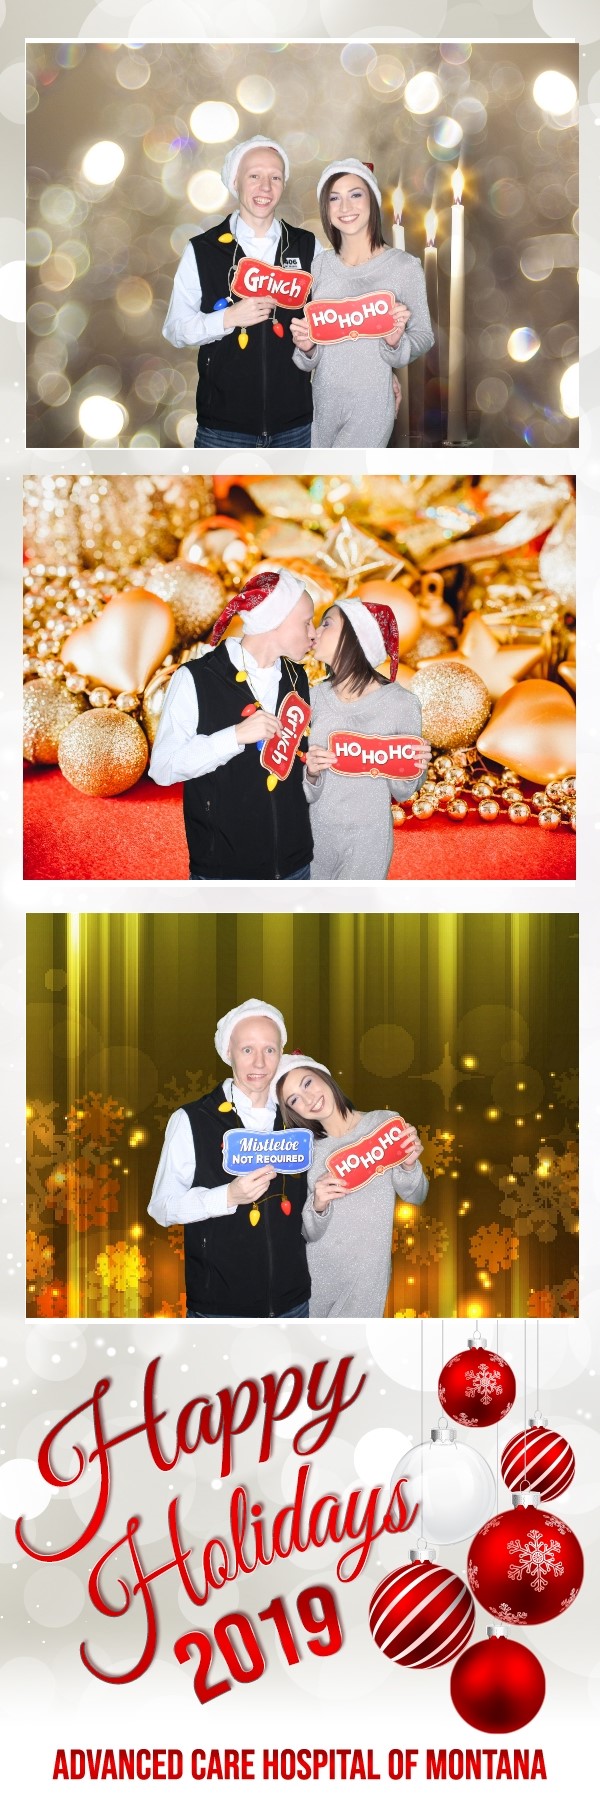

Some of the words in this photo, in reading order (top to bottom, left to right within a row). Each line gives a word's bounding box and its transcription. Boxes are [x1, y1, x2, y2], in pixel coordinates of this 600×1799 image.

[239, 1137, 300, 1152] Mistletoe
[232, 1154, 254, 1165] NOT
[256, 1154, 305, 1164] REQUIRED
